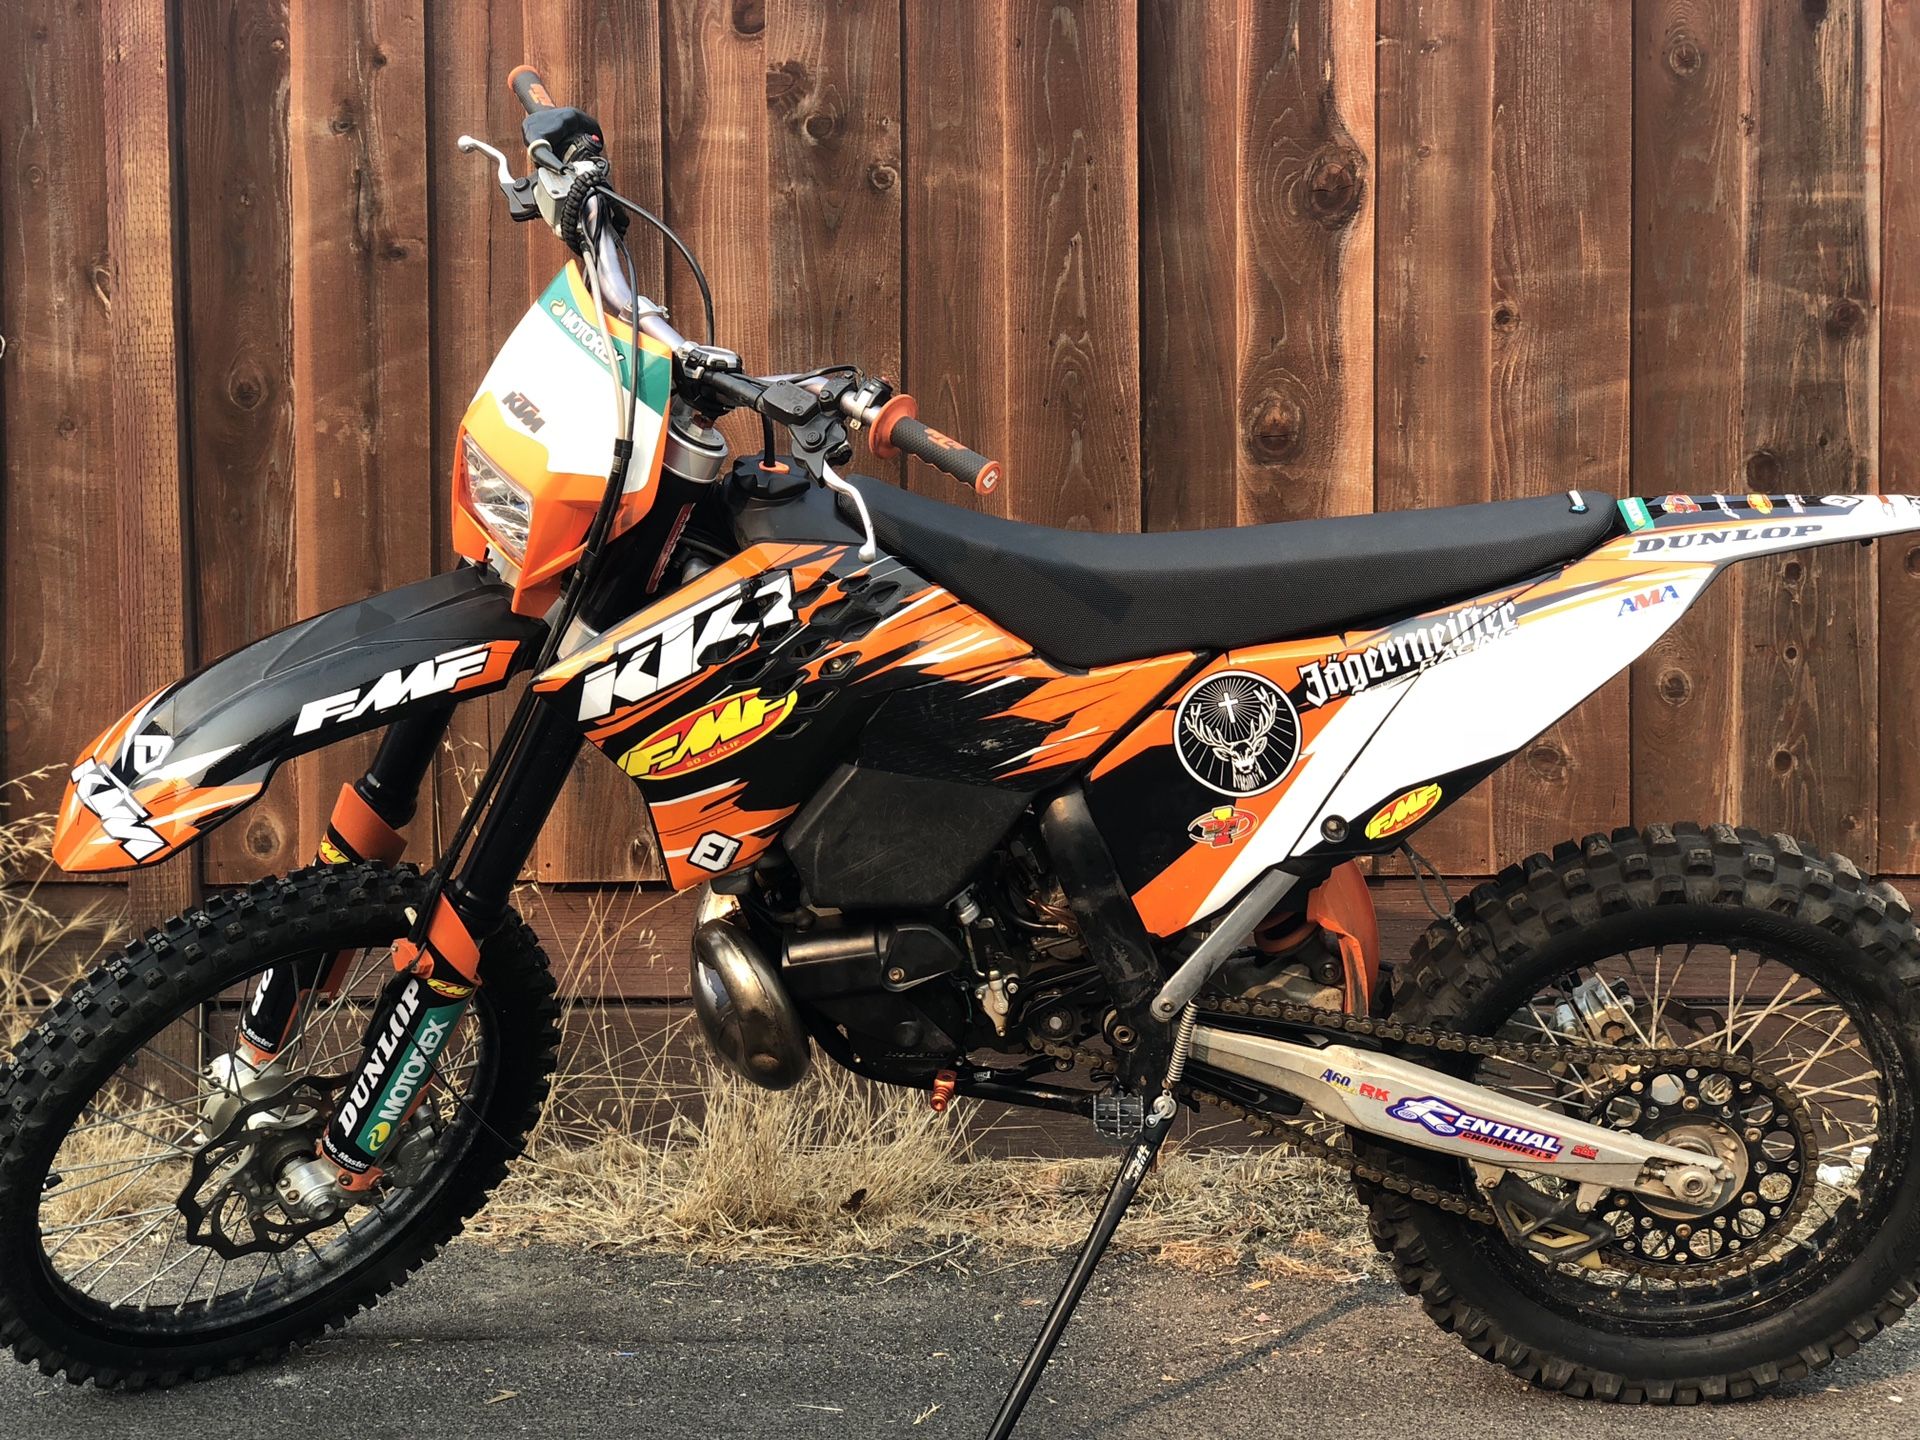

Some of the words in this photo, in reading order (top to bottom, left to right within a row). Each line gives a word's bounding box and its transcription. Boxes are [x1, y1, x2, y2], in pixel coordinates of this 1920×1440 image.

[501, 391, 546, 434] KTM
[1633, 525, 1823, 554] DUNLOP
[1617, 585, 1680, 617] AMA
[577, 574, 794, 721] KTM
[293, 644, 491, 737] FMF
[626, 694, 788, 777] FMF
[708, 739, 746, 759] CALIF.
[1368, 782, 1439, 840] FMF
[338, 979, 420, 1138] DUNLOP
[378, 1018, 450, 1121] MOTOREX
[1359, 1082, 1390, 1102] RK
[1462, 1132, 1554, 1160] CHAINWHEELS
